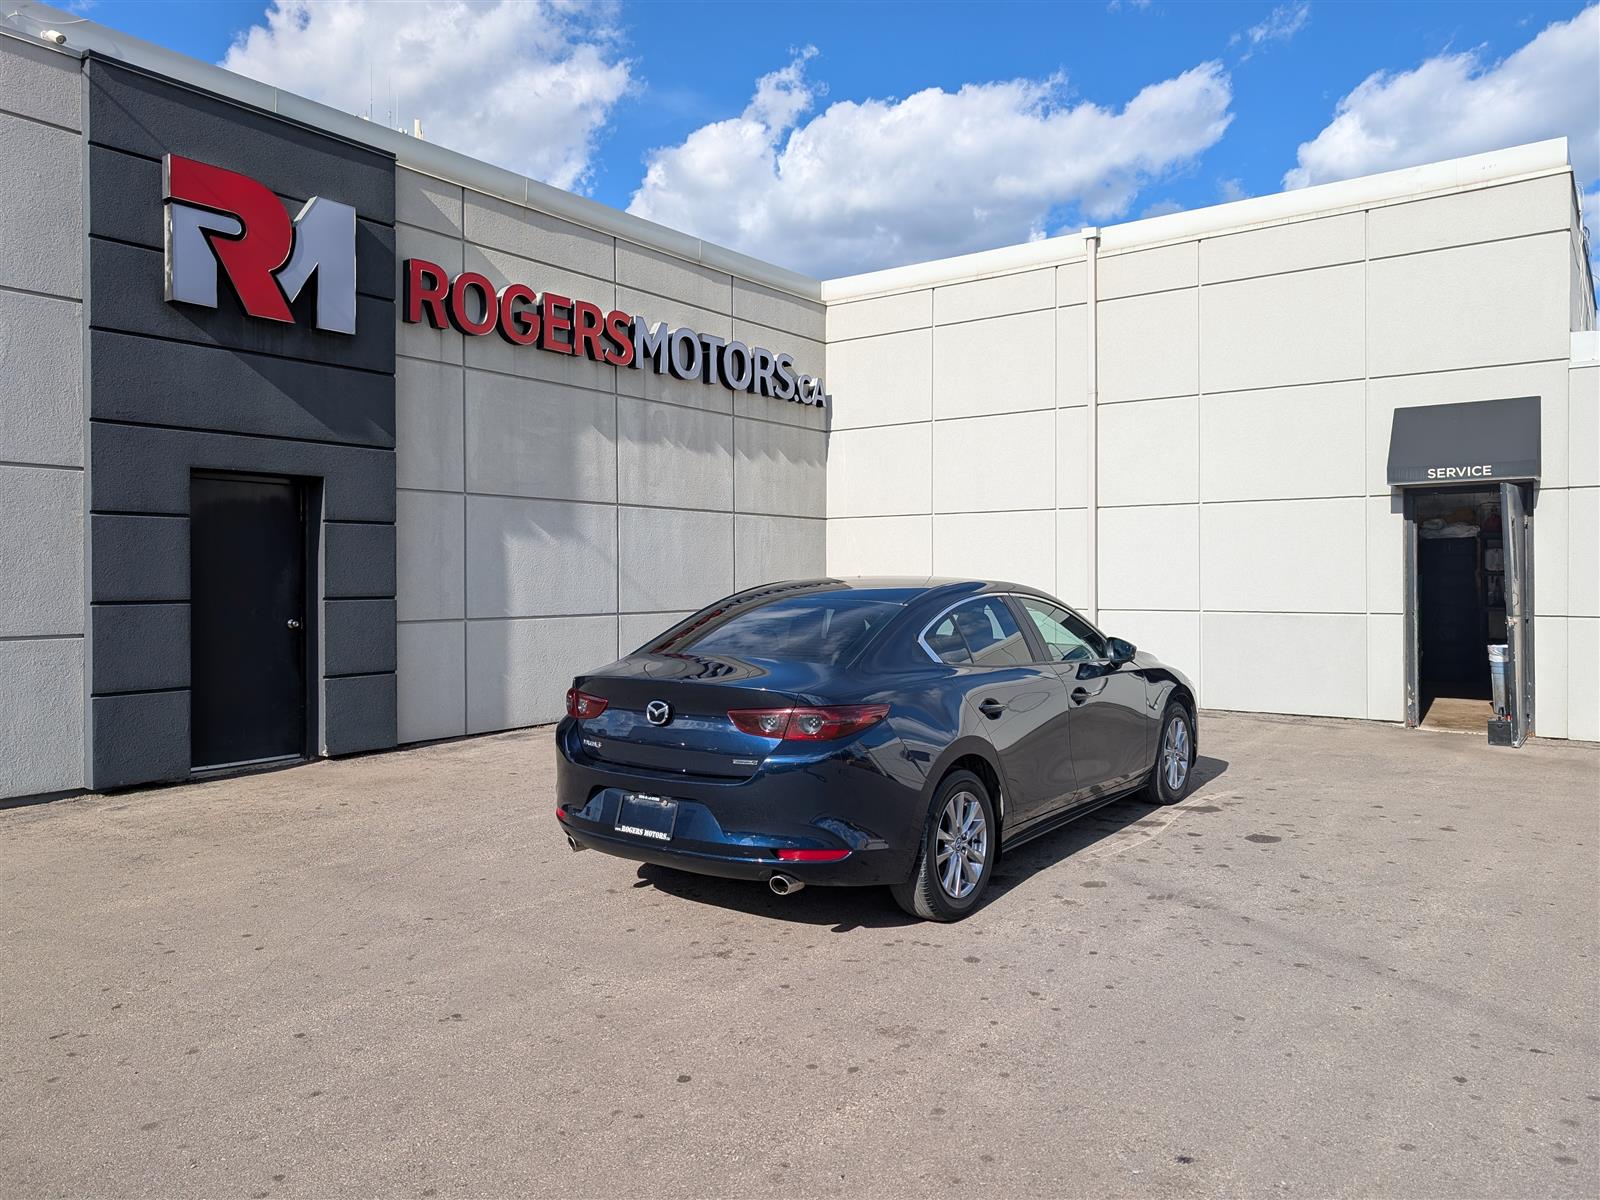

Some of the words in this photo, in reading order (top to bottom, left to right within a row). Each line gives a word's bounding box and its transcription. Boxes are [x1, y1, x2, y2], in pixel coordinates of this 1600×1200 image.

[163, 153, 357, 336] RM
[403, 258, 827, 408] ROGERSMOTORS.CA
[1427, 465, 1493, 479] SERVICE
